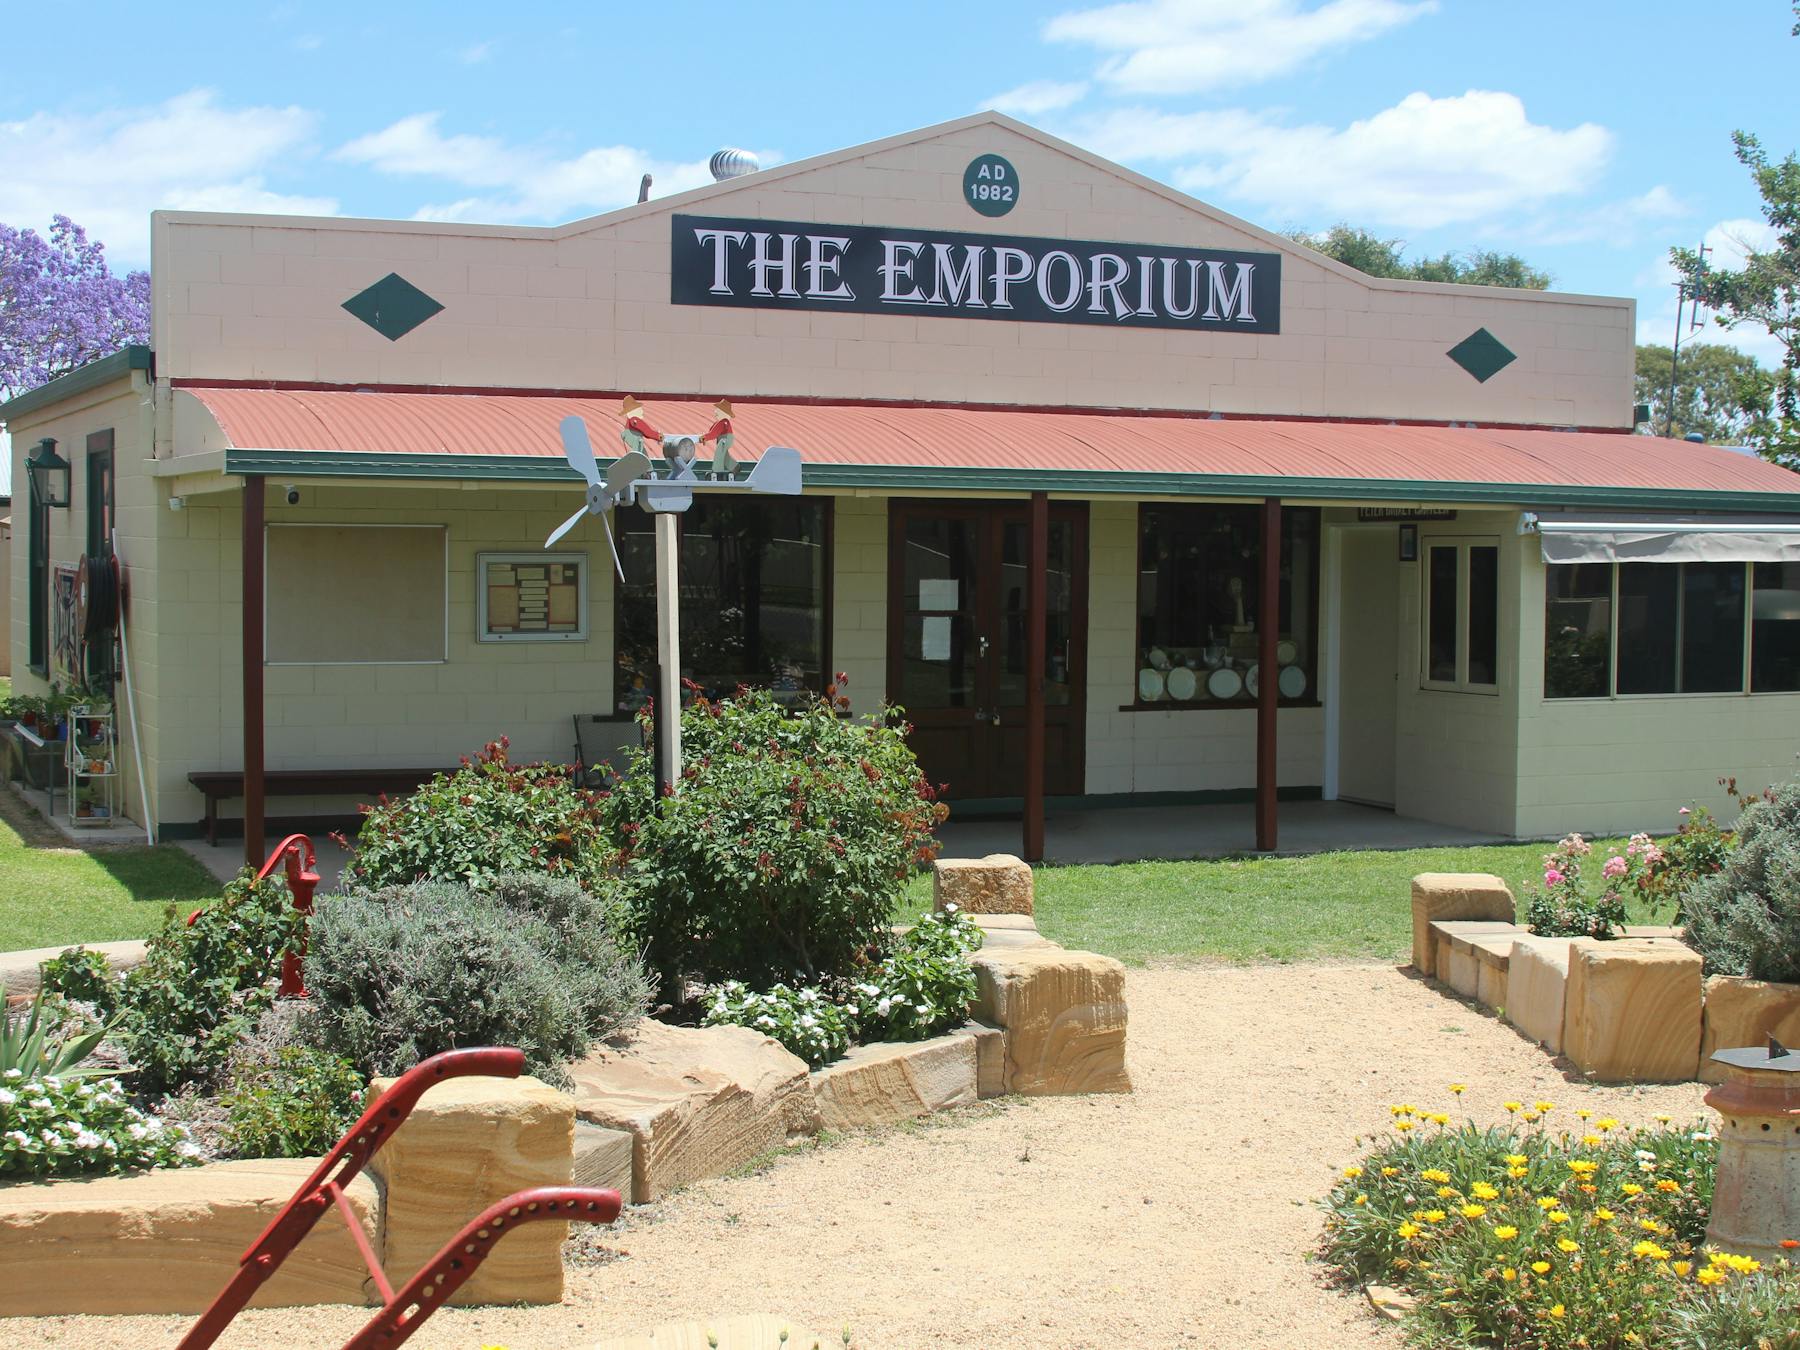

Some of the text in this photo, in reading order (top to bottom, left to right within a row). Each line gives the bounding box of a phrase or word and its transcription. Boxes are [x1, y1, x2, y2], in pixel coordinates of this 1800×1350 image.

[978, 164, 1005, 180] AD
[971, 183, 1013, 202] 1982
[694, 229, 1257, 323] THE EMPORIUM
